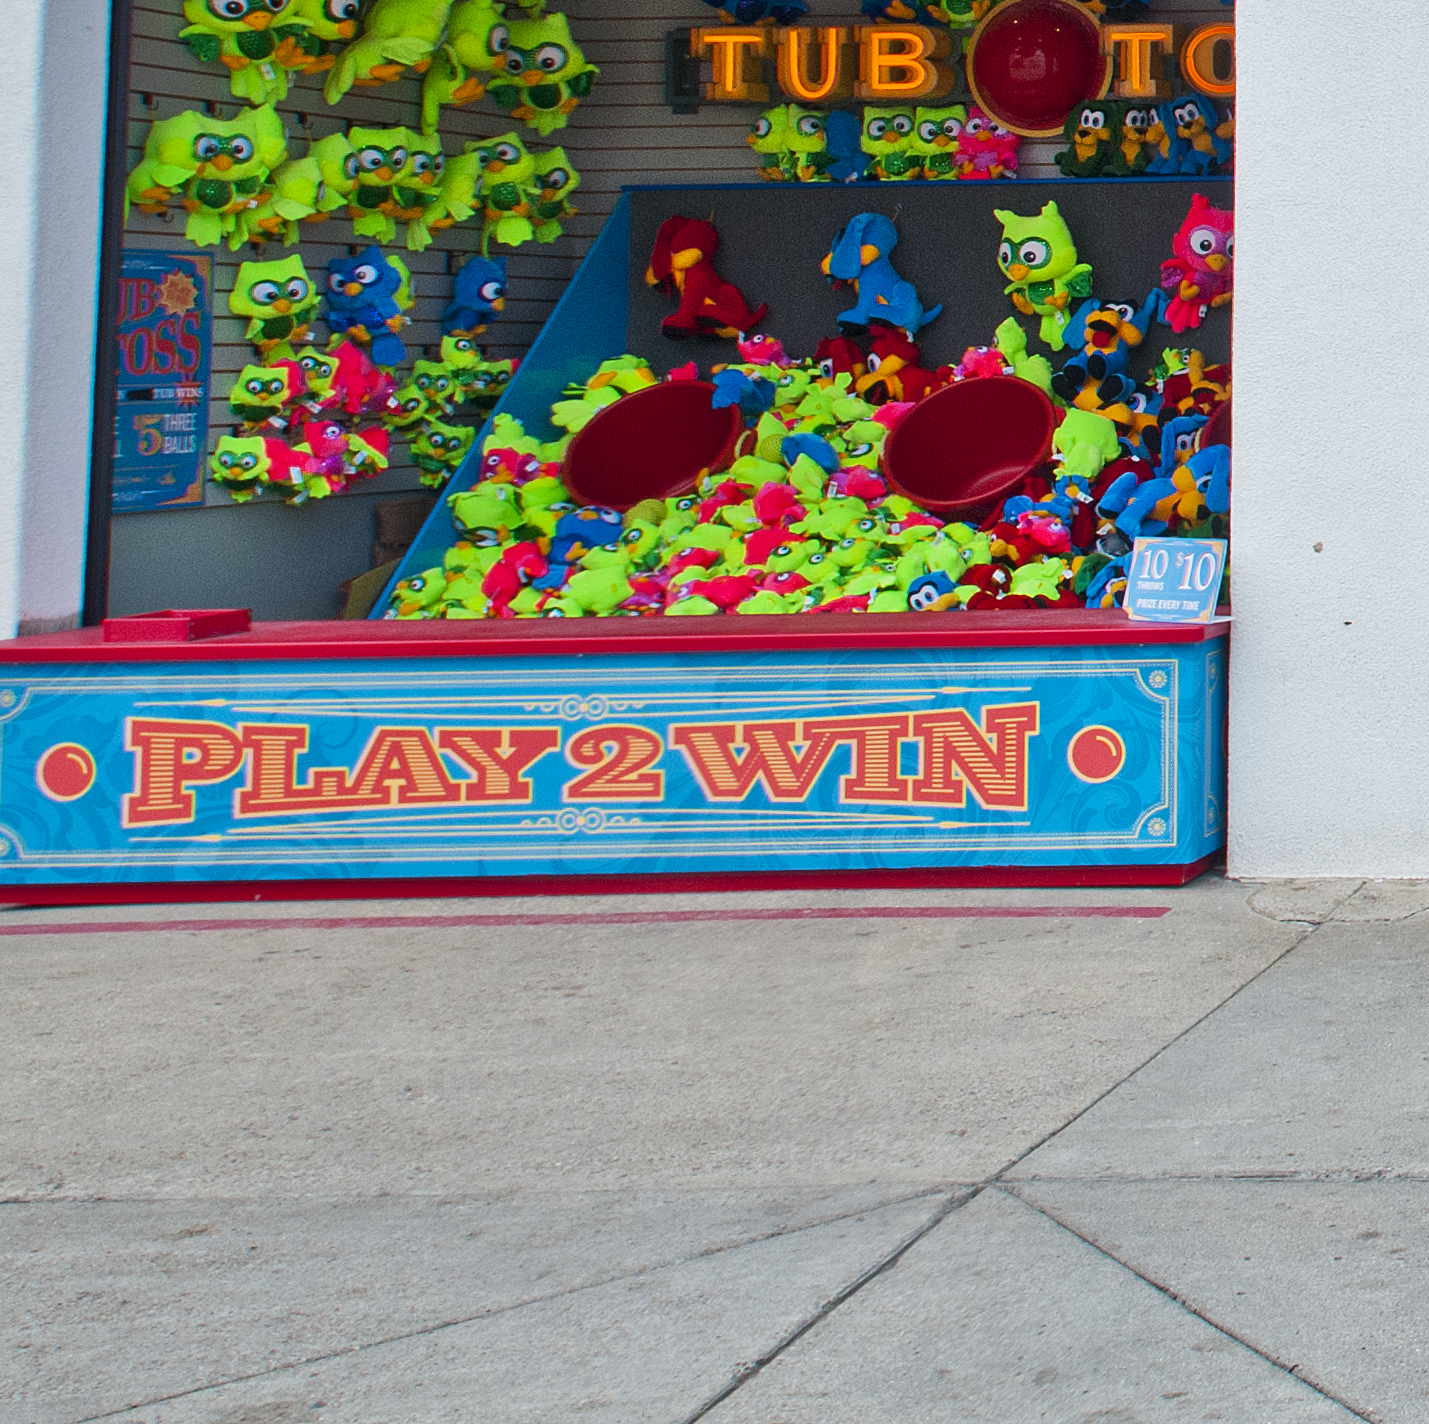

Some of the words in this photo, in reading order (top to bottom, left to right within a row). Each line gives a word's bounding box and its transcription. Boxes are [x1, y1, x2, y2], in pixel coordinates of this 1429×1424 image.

[690, 25, 952, 101] TUB
[1099, 22, 1235, 98] TO
[116, 311, 201, 376] OSS
[162, 413, 197, 432] THREE
[163, 435, 197, 454] BALLS
[1139, 549, 1169, 580] 10
[1175, 551, 1216, 591] $10
[1136, 598, 1157, 609] PRIZE
[1158, 599, 1181, 610] EVERY
[1181, 600, 1200, 611] TIME
